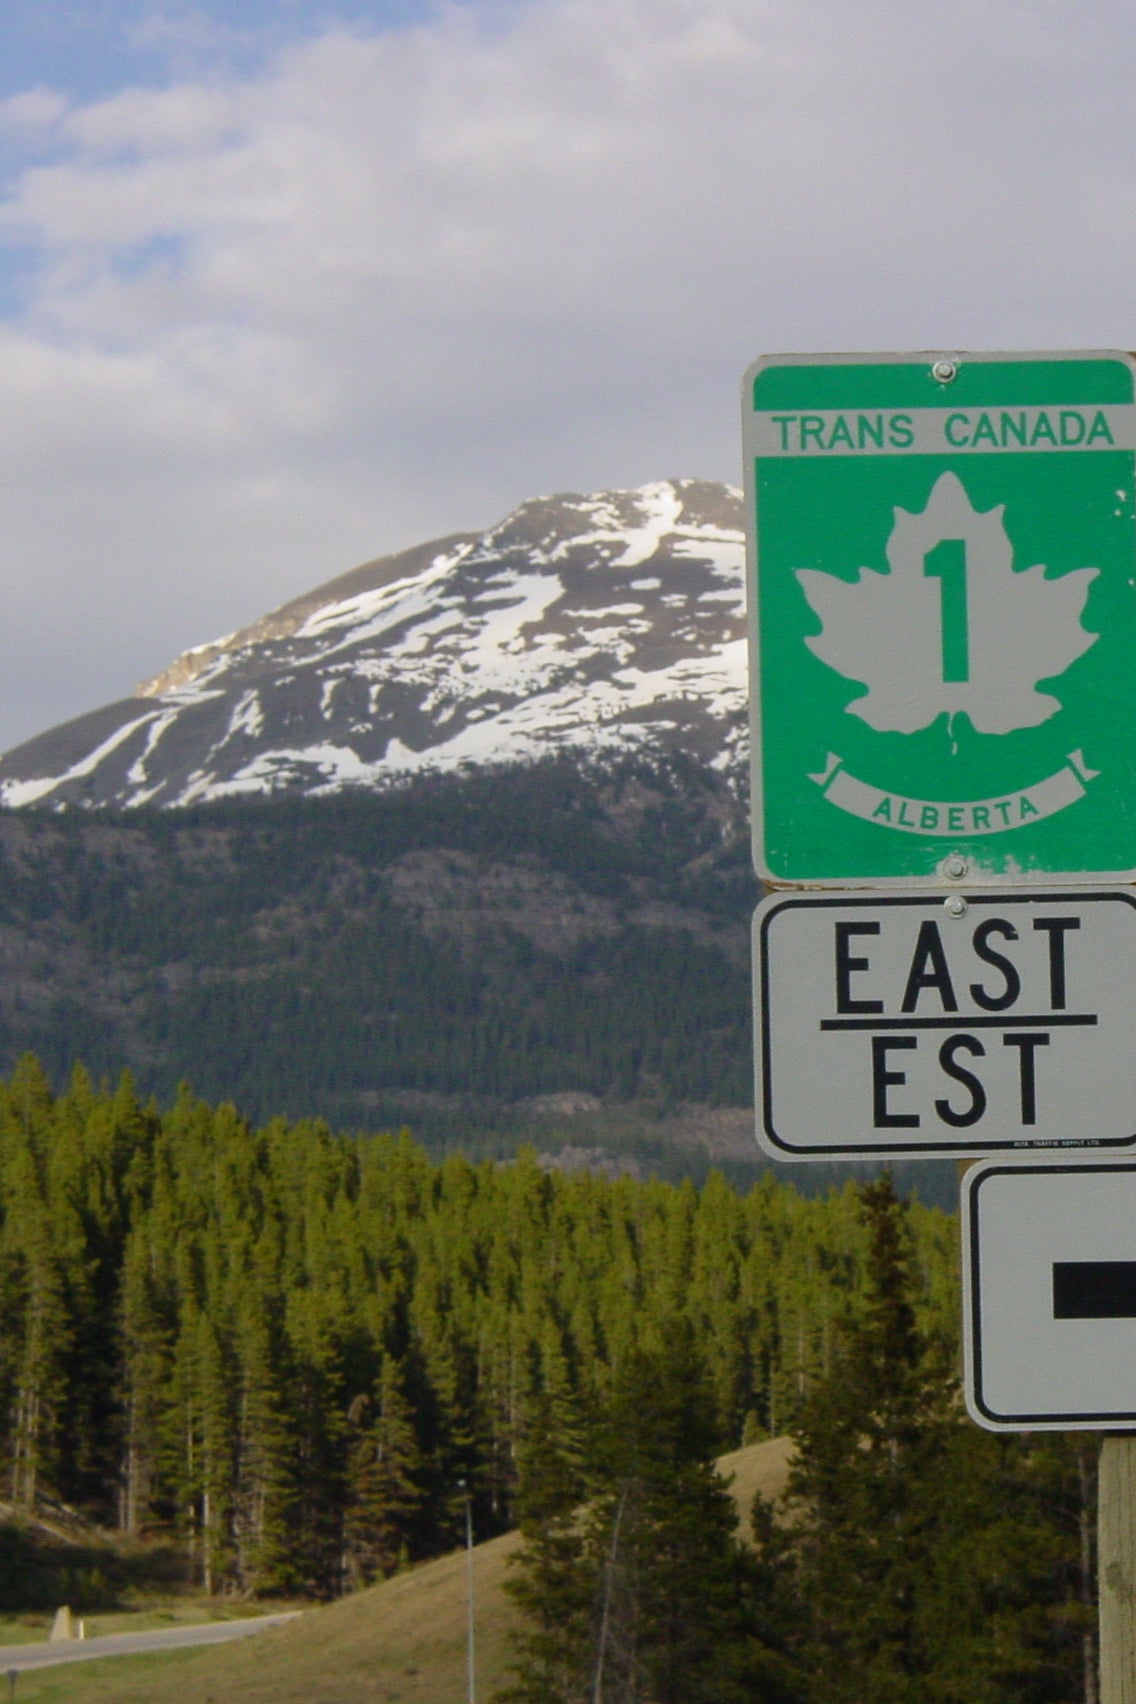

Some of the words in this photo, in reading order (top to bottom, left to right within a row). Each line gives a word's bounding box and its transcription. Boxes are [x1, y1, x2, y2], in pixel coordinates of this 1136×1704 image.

[772, 414, 915, 450] TRANS
[944, 410, 1115, 447] CANADA
[923, 538, 970, 683] 1
[872, 796, 1039, 831] ALBERTA
[835, 916, 1081, 1015] EAST
[872, 1033, 1050, 1129] EST
